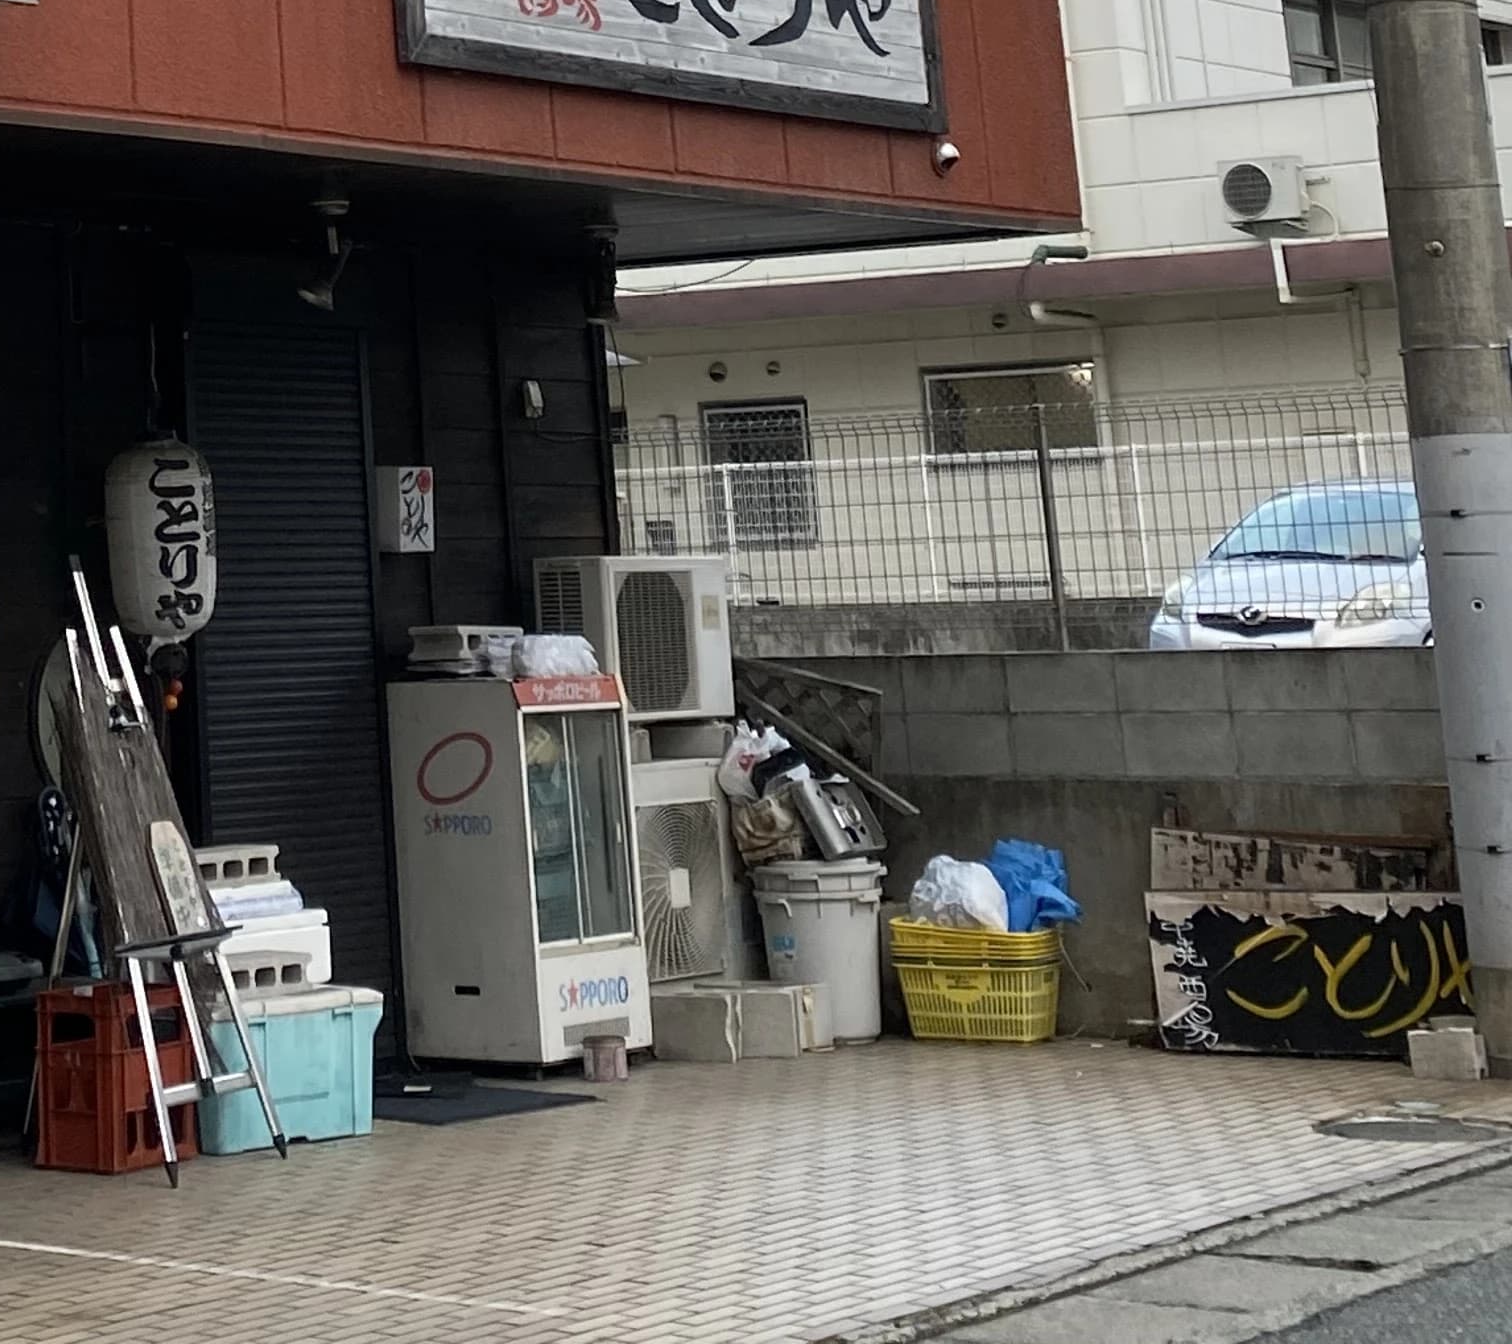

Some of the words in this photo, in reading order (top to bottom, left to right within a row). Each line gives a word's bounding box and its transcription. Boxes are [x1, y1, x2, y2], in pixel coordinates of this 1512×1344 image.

[532, 681, 601, 703] サッポロビール
